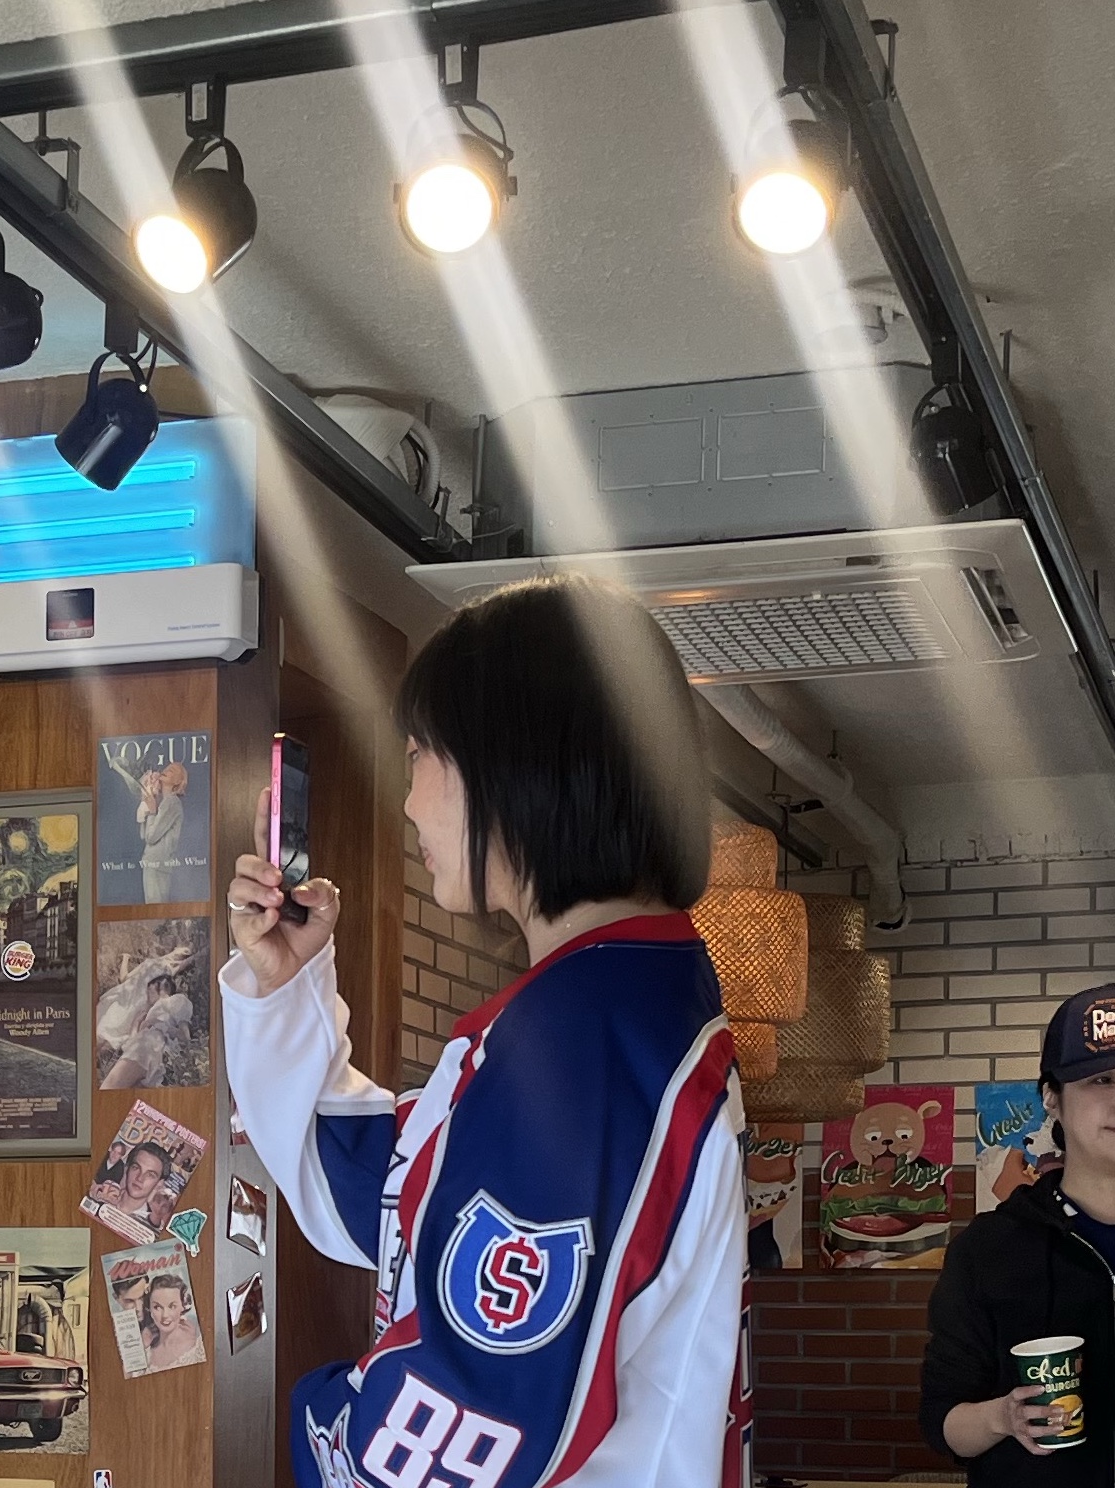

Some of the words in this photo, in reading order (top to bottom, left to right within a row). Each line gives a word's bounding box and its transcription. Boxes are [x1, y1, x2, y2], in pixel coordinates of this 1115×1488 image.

[101, 735, 209, 768] VOGUE
[102, 861, 124, 871] What
[139, 860, 161, 869] Wear
[164, 857, 181, 867] with
[185, 855, 207, 866] What
[5, 957, 31, 969] KING
[34, 1008, 42, 1020] in
[46, 1006, 70, 1019] Paris
[107, 1253, 181, 1281] Woman
